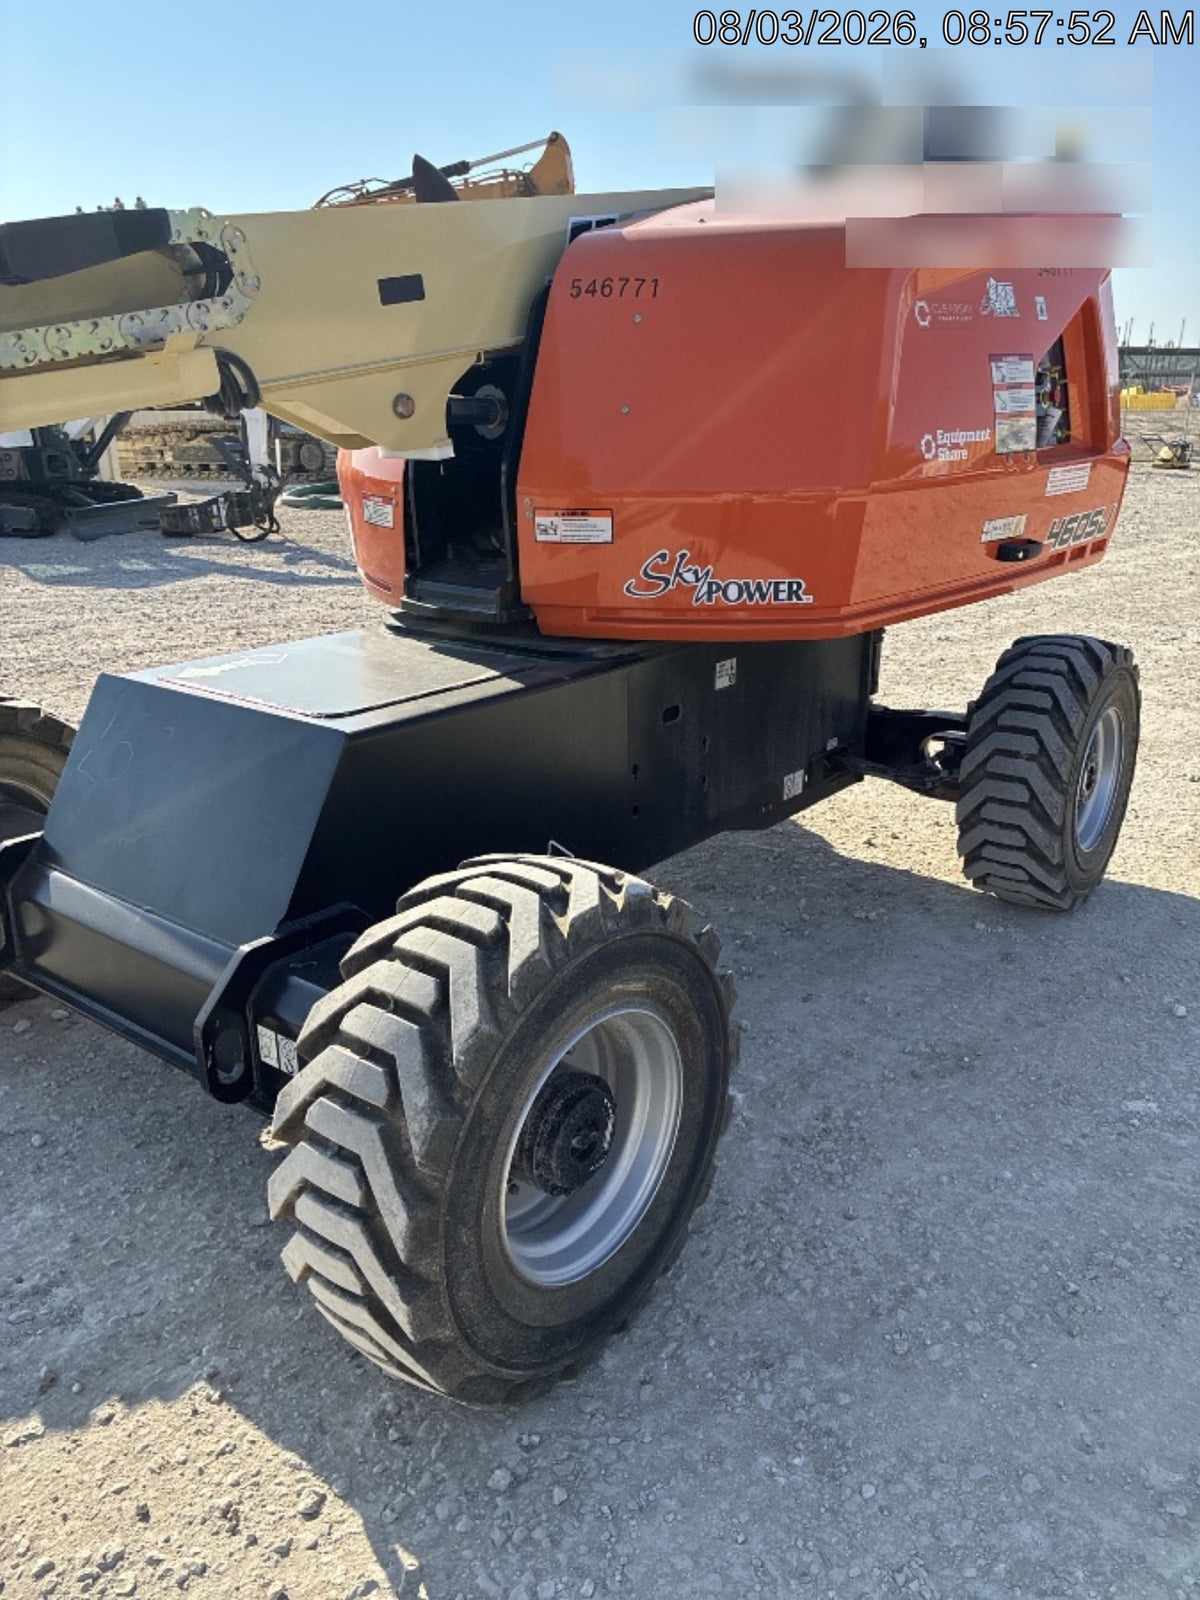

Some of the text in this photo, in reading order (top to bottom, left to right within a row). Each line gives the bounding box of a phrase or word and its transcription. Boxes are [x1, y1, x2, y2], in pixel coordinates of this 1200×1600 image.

[570, 277, 659, 299] 546771
[936, 428, 991, 446] Equipment
[938, 447, 968, 461] Share
[624, 550, 806, 606] Sky POWER
